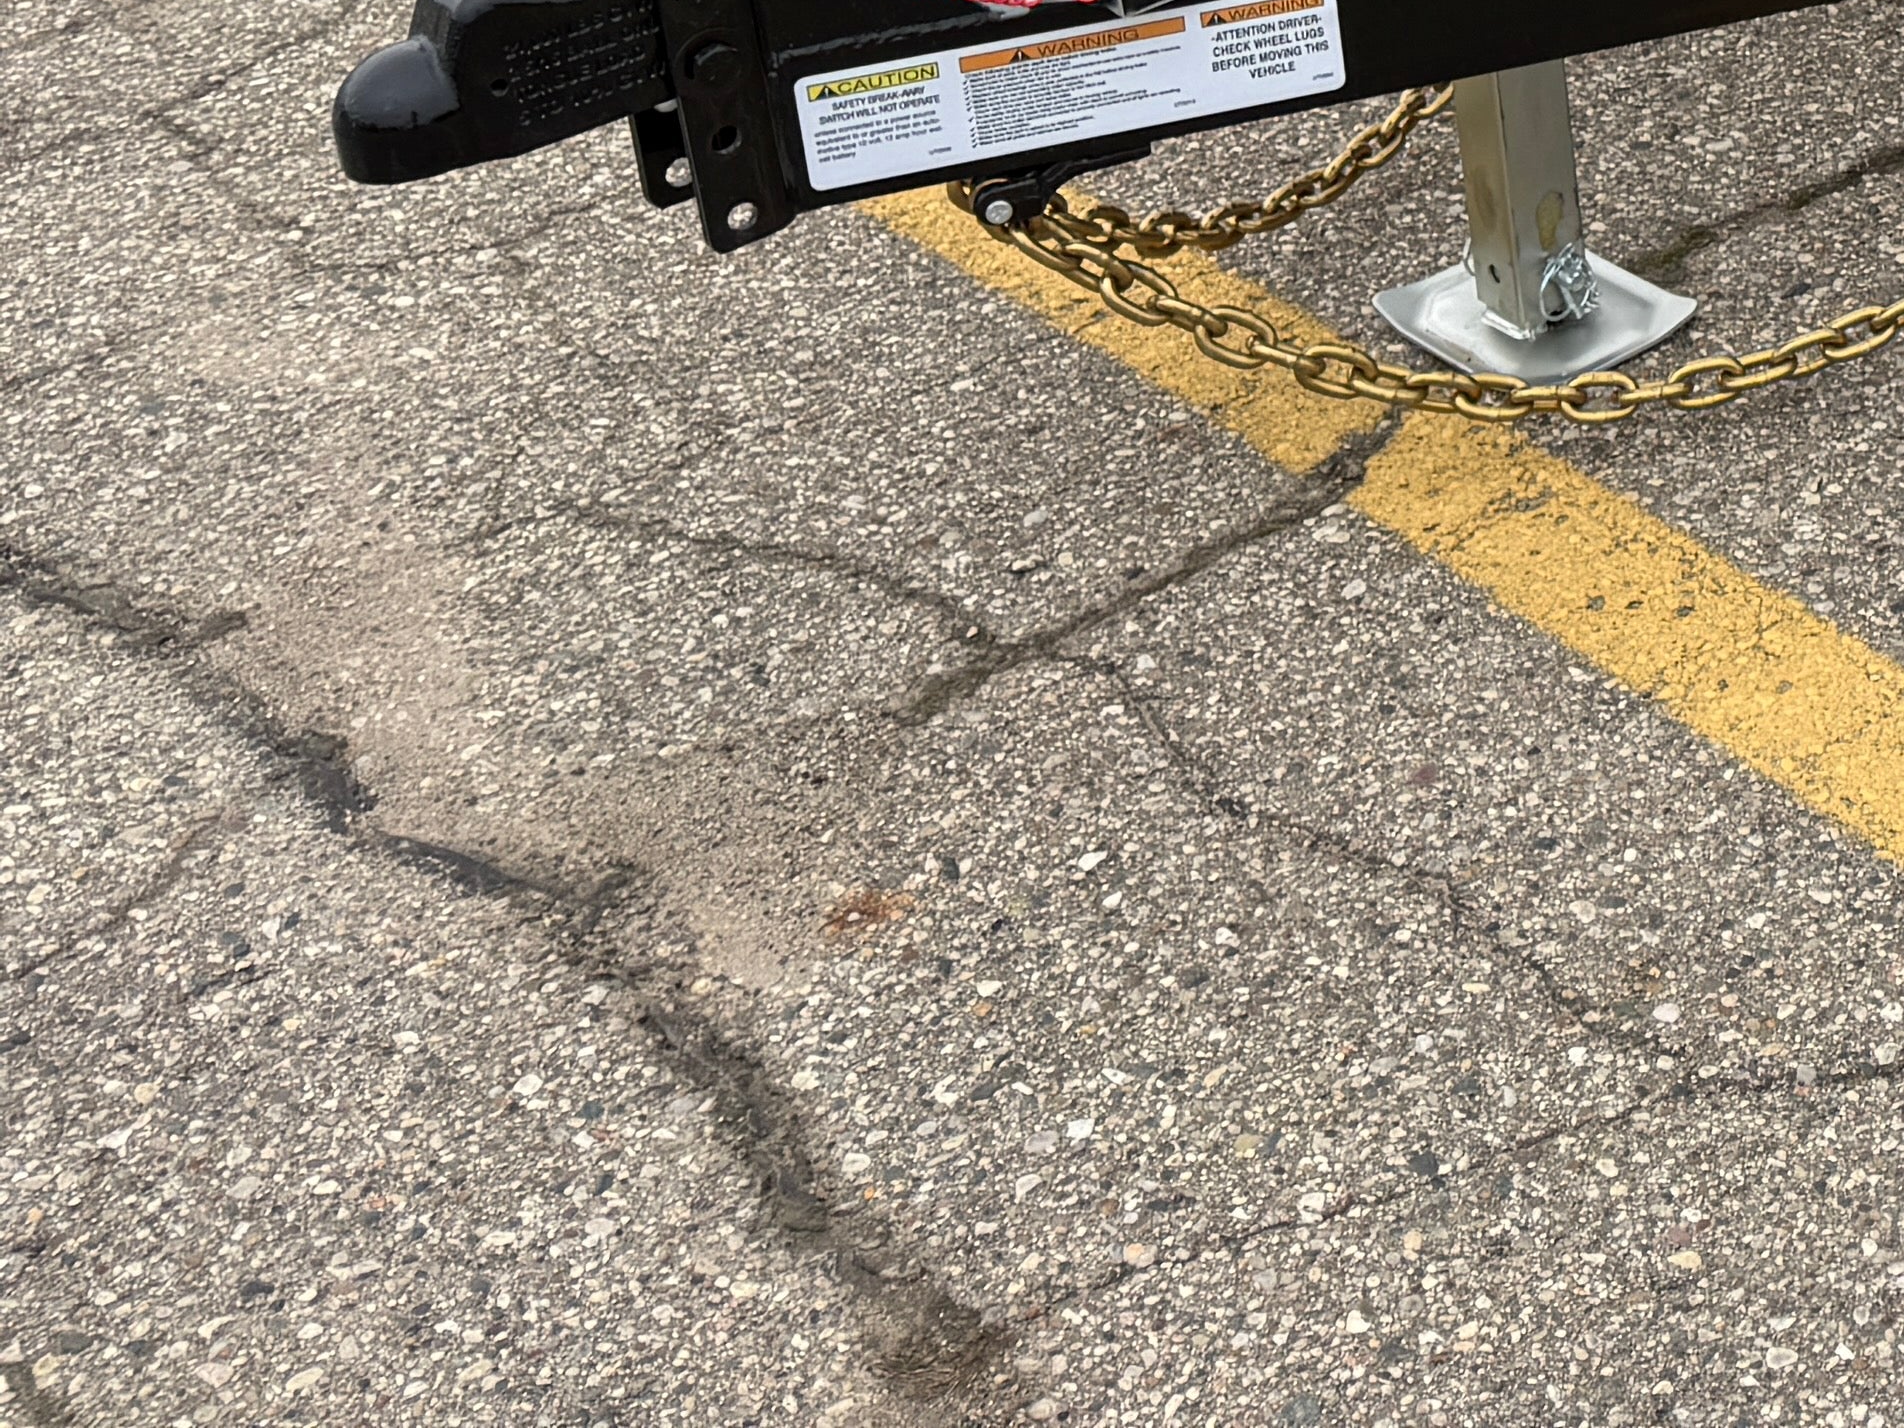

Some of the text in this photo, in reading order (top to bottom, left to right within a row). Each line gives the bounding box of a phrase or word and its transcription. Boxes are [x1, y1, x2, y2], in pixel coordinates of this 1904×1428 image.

[1036, 28, 1140, 58] WARNING
[1211, 22, 1276, 42] -ATTENTION
[1212, 26, 1326, 58] CHECK WHEEL LUGS
[1211, 40, 1330, 73] BEFORE MOVING THIS
[1248, 60, 1297, 80] VEHICLE
[837, 65, 936, 95] CAUTION
[831, 96, 867, 112] SAFETY
[856, 106, 878, 119] WILL
[878, 102, 898, 116] NOT
[899, 94, 941, 111] OPERATE
